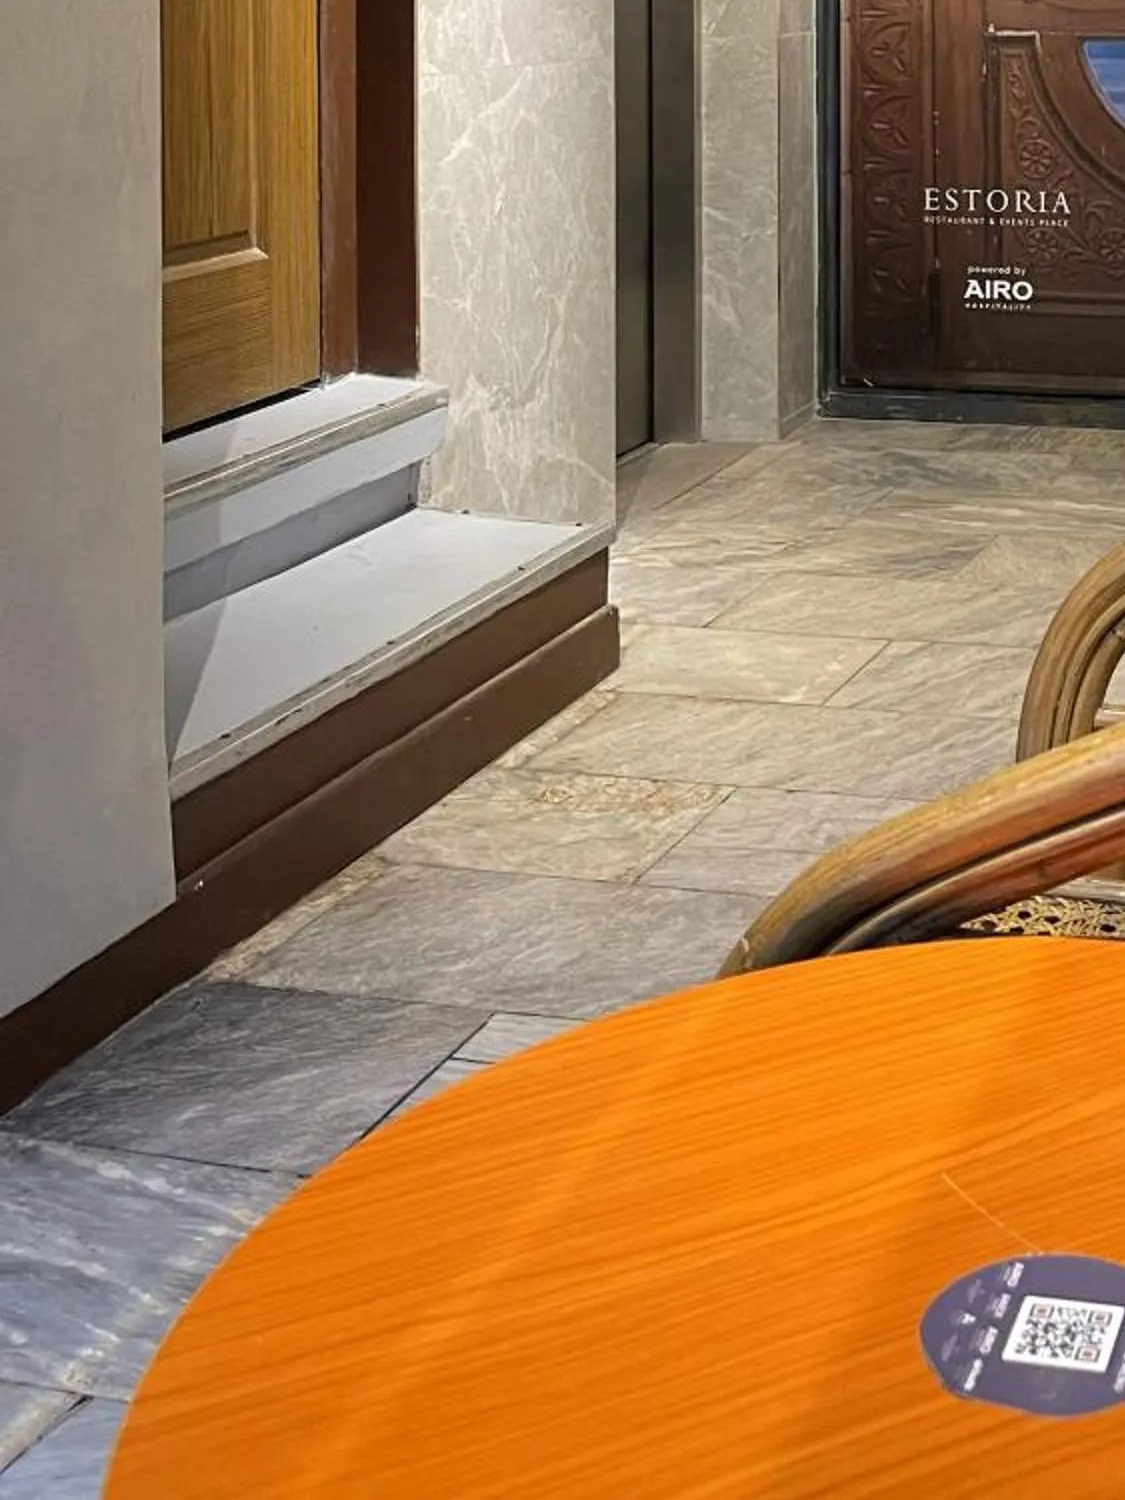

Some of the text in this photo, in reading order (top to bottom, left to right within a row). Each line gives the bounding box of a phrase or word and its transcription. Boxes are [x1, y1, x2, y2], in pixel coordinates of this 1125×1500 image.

[923, 187, 1071, 215] ESTORIA
[923, 216, 985, 226] RESTAURANT
[967, 266, 1026, 277] powered by
[963, 279, 1034, 301] AIRO
